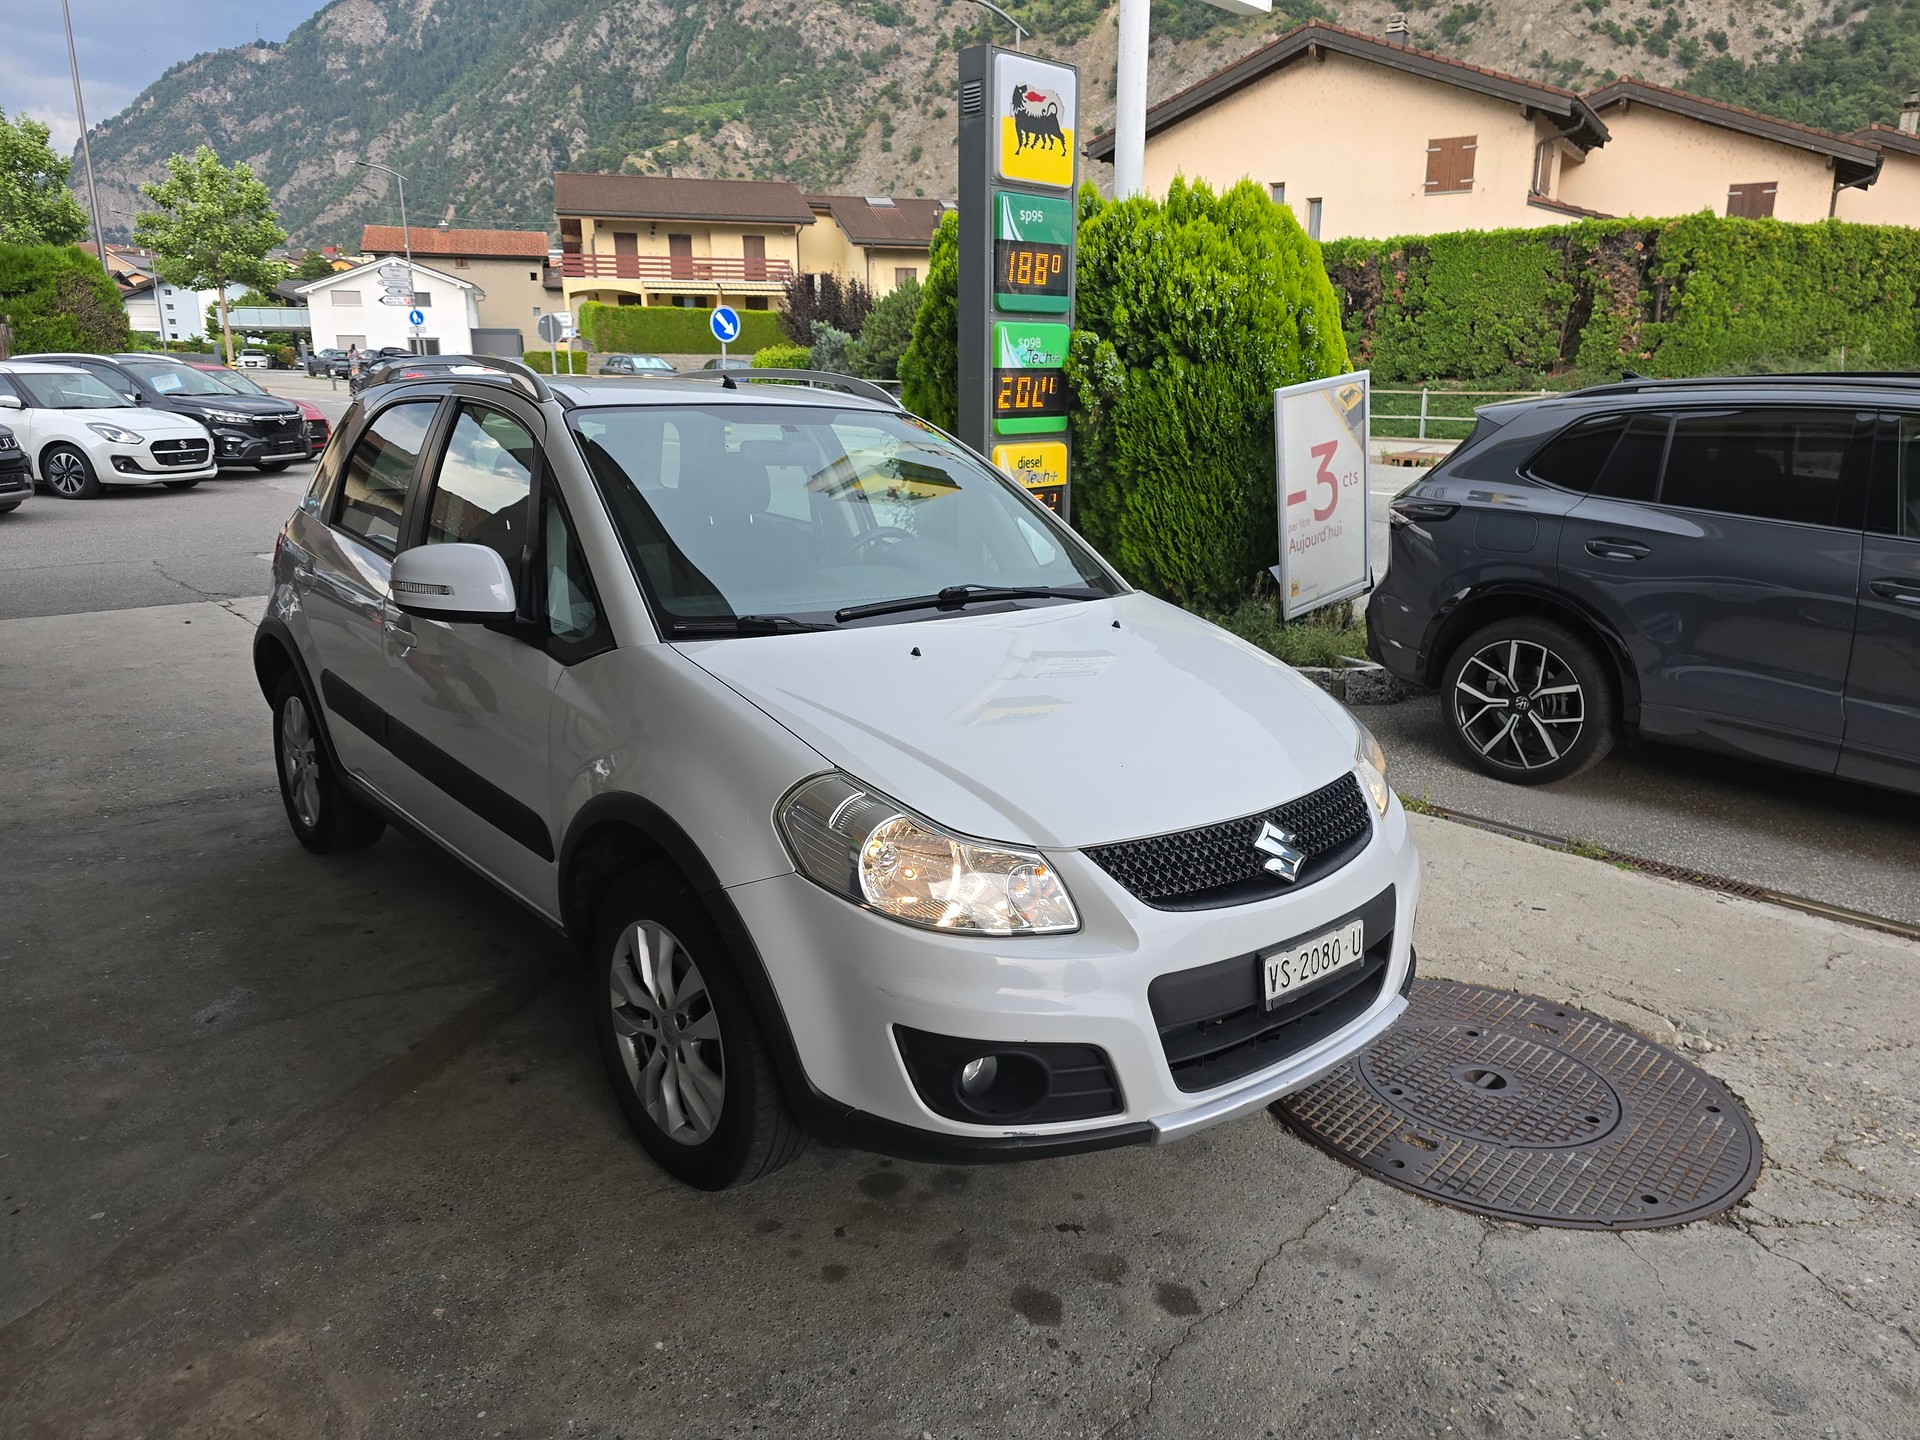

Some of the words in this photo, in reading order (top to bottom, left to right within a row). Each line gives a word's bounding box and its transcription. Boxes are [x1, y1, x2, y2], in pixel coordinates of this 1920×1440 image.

[1019, 209, 1044, 224] sp95
[1017, 337, 1042, 349] sp98
[1026, 348, 1061, 364] Tech+
[1017, 455, 1043, 469] diesel
[1025, 469, 1059, 484] Tech+
[1342, 470, 1359, 488] cts
[1287, 521, 1299, 534] par
[1299, 517, 1312, 529] litre
[1288, 520, 1343, 555] Aujourd'hui
